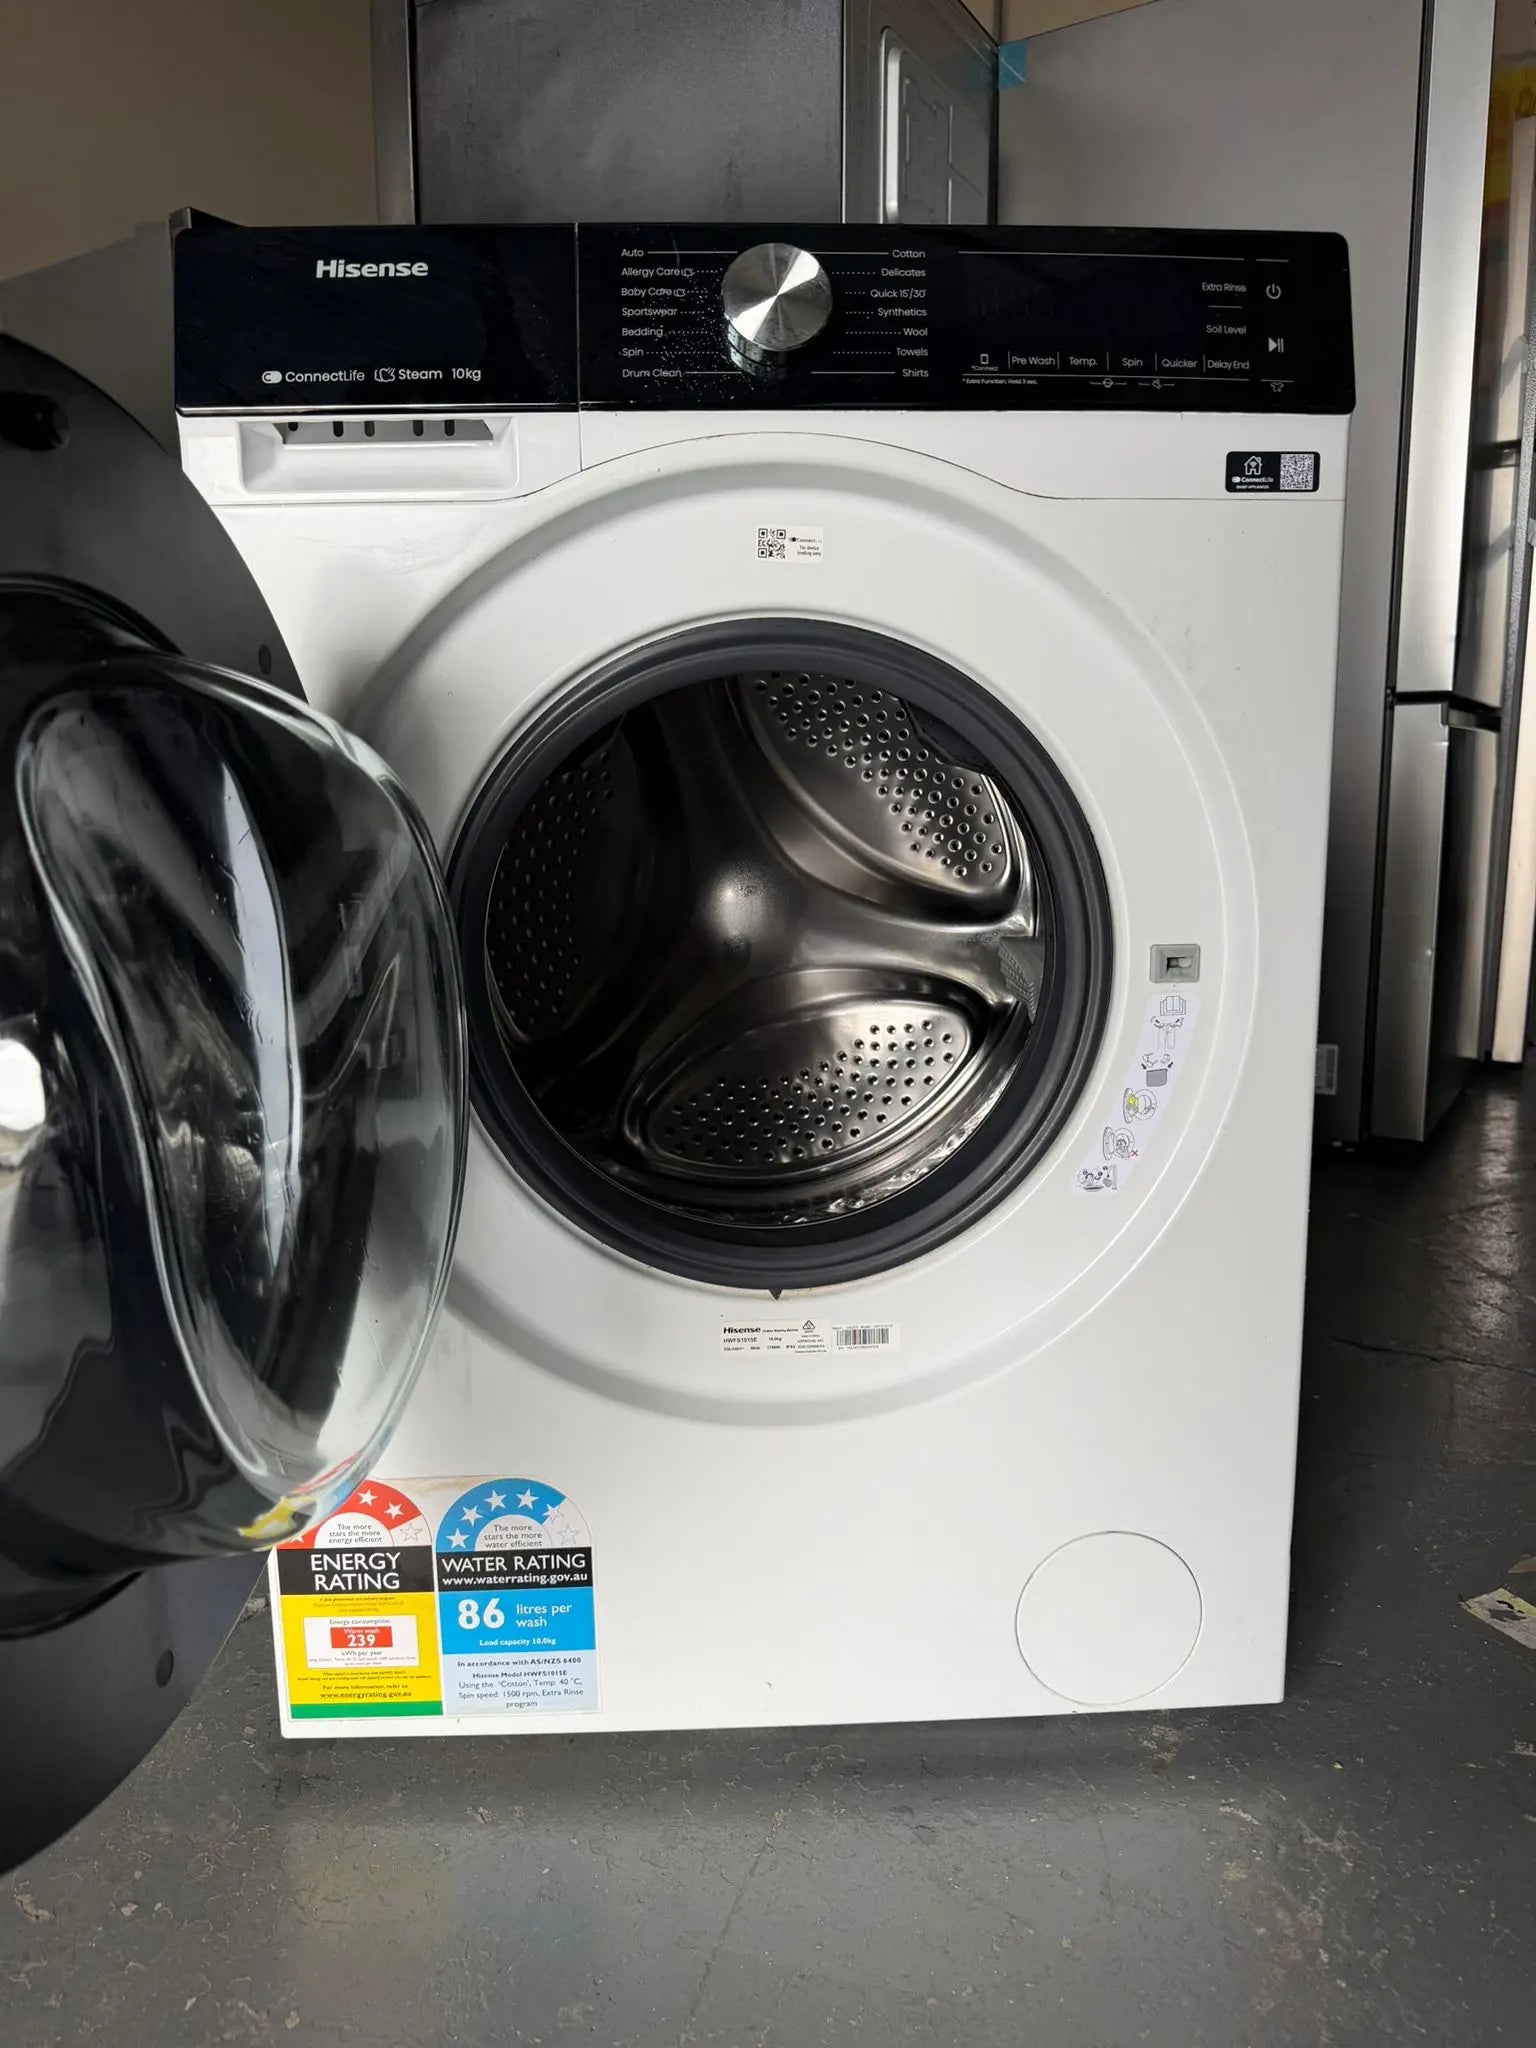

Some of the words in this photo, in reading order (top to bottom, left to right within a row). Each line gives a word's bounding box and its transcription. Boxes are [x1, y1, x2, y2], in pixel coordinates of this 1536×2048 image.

[621, 249, 644, 257] Auto
[892, 249, 926, 258] Cotton
[316, 260, 428, 278] Hisense
[621, 267, 655, 278] Allergy
[656, 267, 680, 276] Care
[881, 268, 926, 277] Delicates
[1202, 282, 1222, 291] Extra
[1224, 283, 1247, 292] Rinse
[621, 287, 646, 298] Baby
[648, 287, 672, 296] Care
[870, 289, 898, 298] Quick
[622, 307, 678, 317] Sportswear
[878, 308, 927, 318] Synthetics
[622, 327, 663, 338] Bedding
[903, 328, 928, 336] Wool
[1206, 324, 1222, 333] Soil
[1224, 325, 1246, 334] Level
[622, 347, 644, 358] Spin
[896, 347, 928, 356] Towels
[1012, 356, 1027, 365] Pre
[1029, 356, 1056, 365] Wash
[1068, 356, 1097, 367] Temp.
[1122, 357, 1143, 368] Spin
[1162, 358, 1197, 368] Quicker
[1207, 360, 1232, 371] Delay
[1233, 360, 1250, 369] End
[286, 370, 365, 382] ConnectLife
[399, 369, 442, 380] Steam
[452, 368, 481, 382] 10kg
[622, 368, 650, 378] Drum
[652, 368, 682, 377] Clean
[902, 368, 929, 377] Shirts
[494, 1524, 509, 1532] The
[310, 1552, 400, 1572] ENERGY
[442, 1556, 507, 1573] WATER
[514, 1553, 586, 1570] RATING
[314, 1572, 400, 1591] RATING
[442, 1572, 588, 1585] www.waterrating.gov.au
[458, 1597, 505, 1630] 86
[516, 1603, 547, 1614] litres
[551, 1603, 572, 1616] per
[516, 1616, 547, 1628] wash
[347, 1634, 376, 1647] 239
[500, 1638, 530, 1647] capacity
[459, 1692, 474, 1700] Spin
